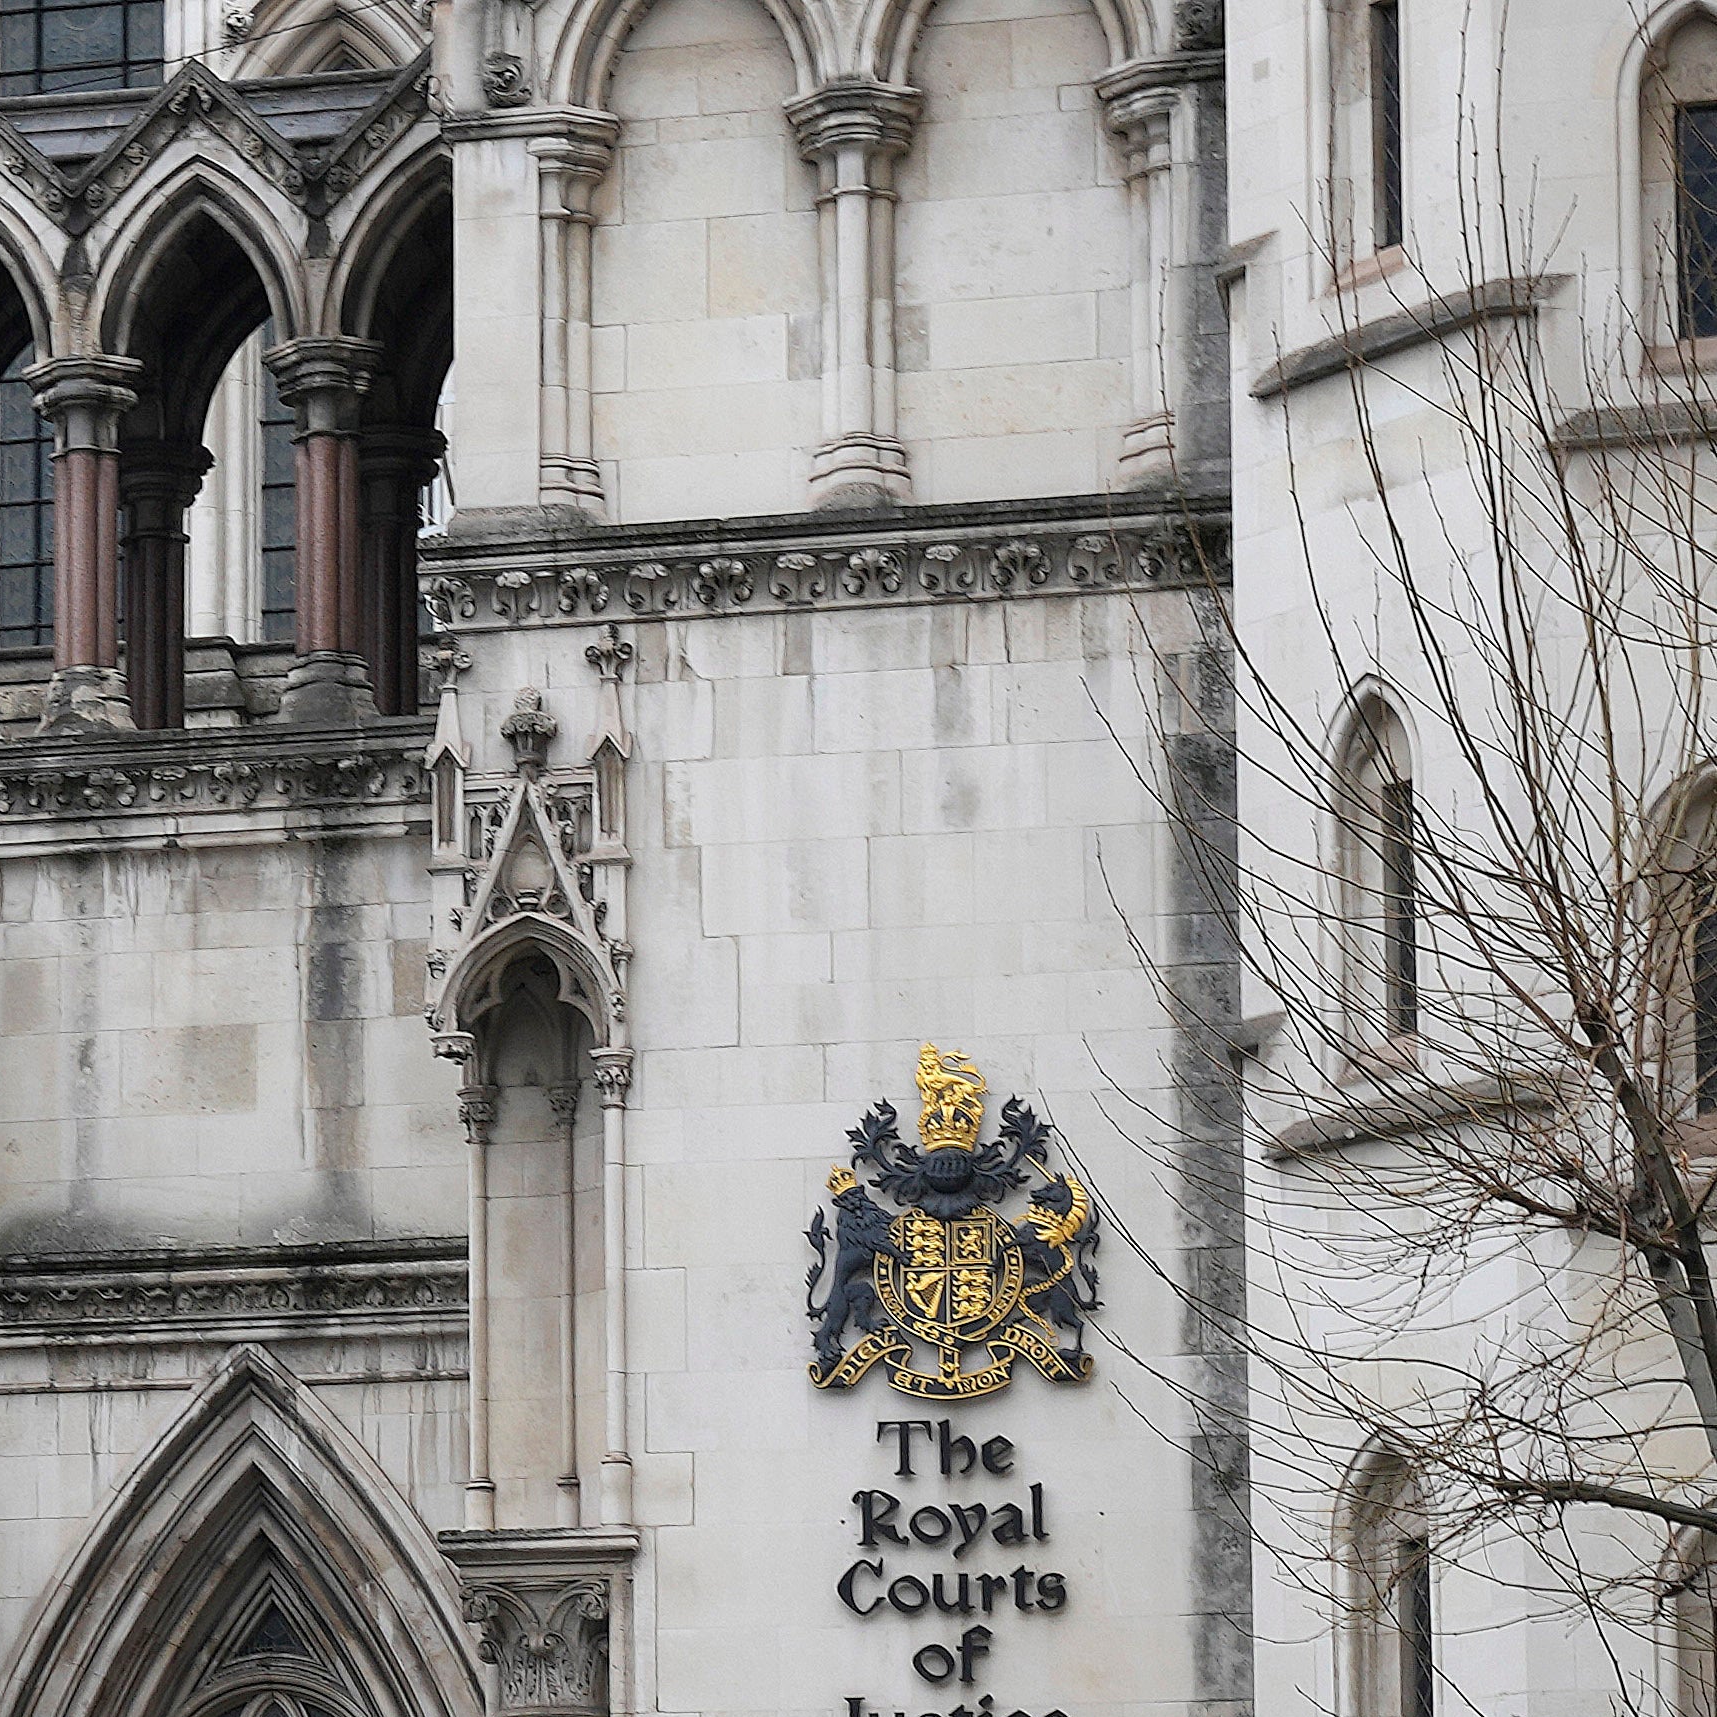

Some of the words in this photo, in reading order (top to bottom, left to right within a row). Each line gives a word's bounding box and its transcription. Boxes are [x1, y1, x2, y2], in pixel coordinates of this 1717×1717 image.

[1003, 1326, 1065, 1378] DROIT
[877, 1419, 1015, 1480] The
[852, 1483, 1049, 1559] Royal
[837, 1559, 1068, 1616] Courts
[912, 1624, 994, 1688] of
